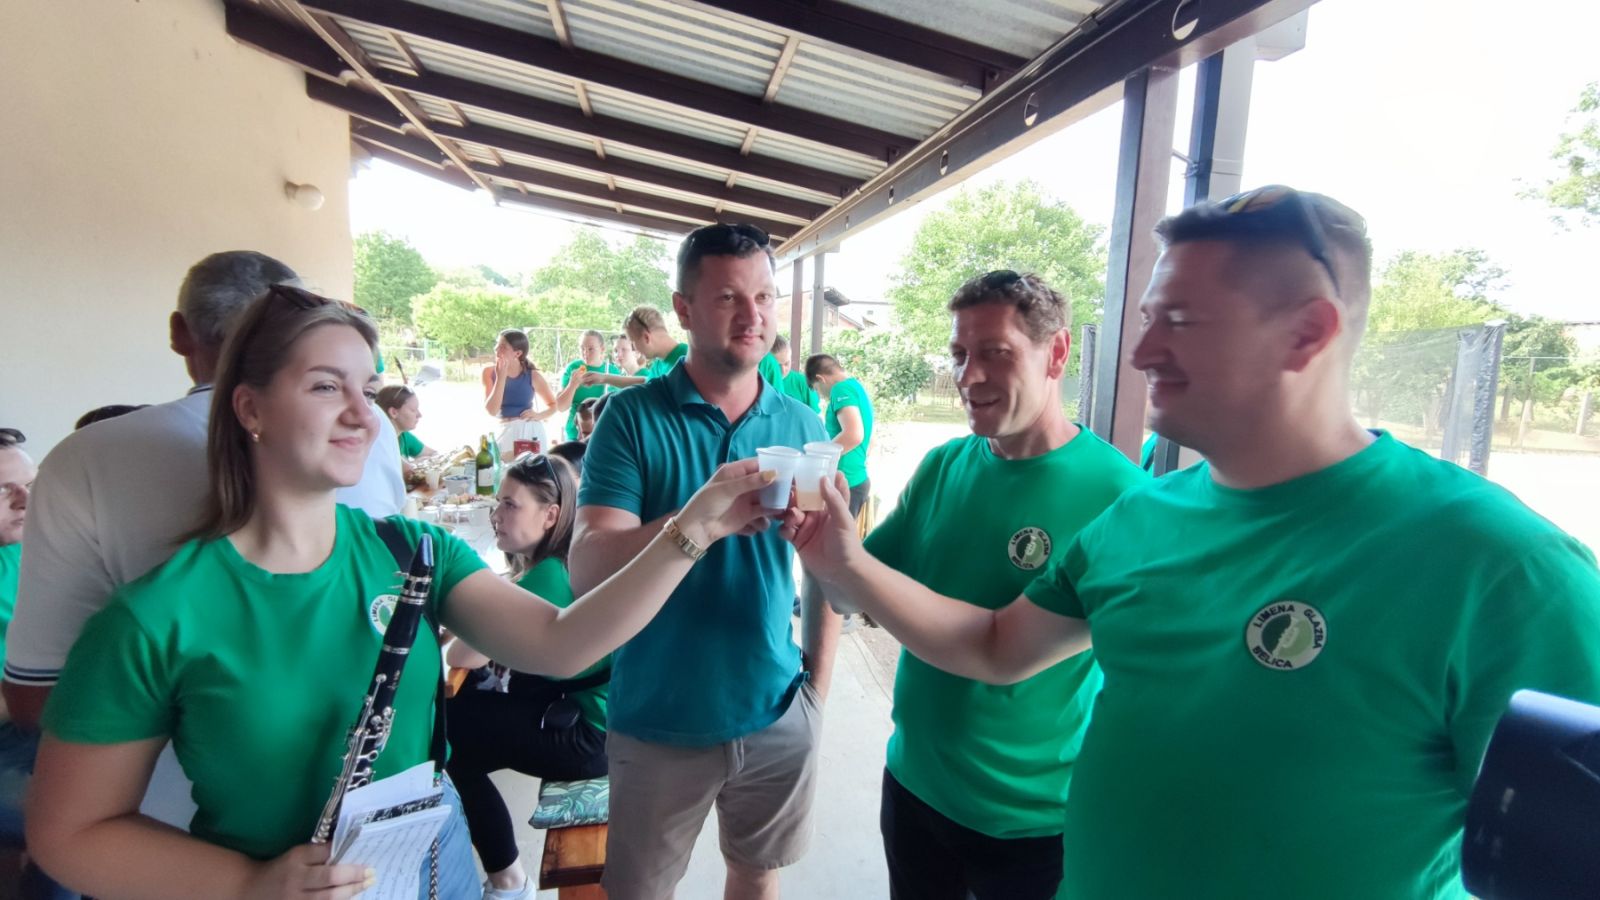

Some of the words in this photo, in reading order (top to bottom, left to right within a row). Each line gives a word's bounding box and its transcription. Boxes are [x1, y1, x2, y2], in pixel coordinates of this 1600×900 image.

[1253, 604, 1295, 628] LIMENA
[1303, 608, 1324, 649] GLAZBA
[1252, 645, 1293, 668] BELICA
